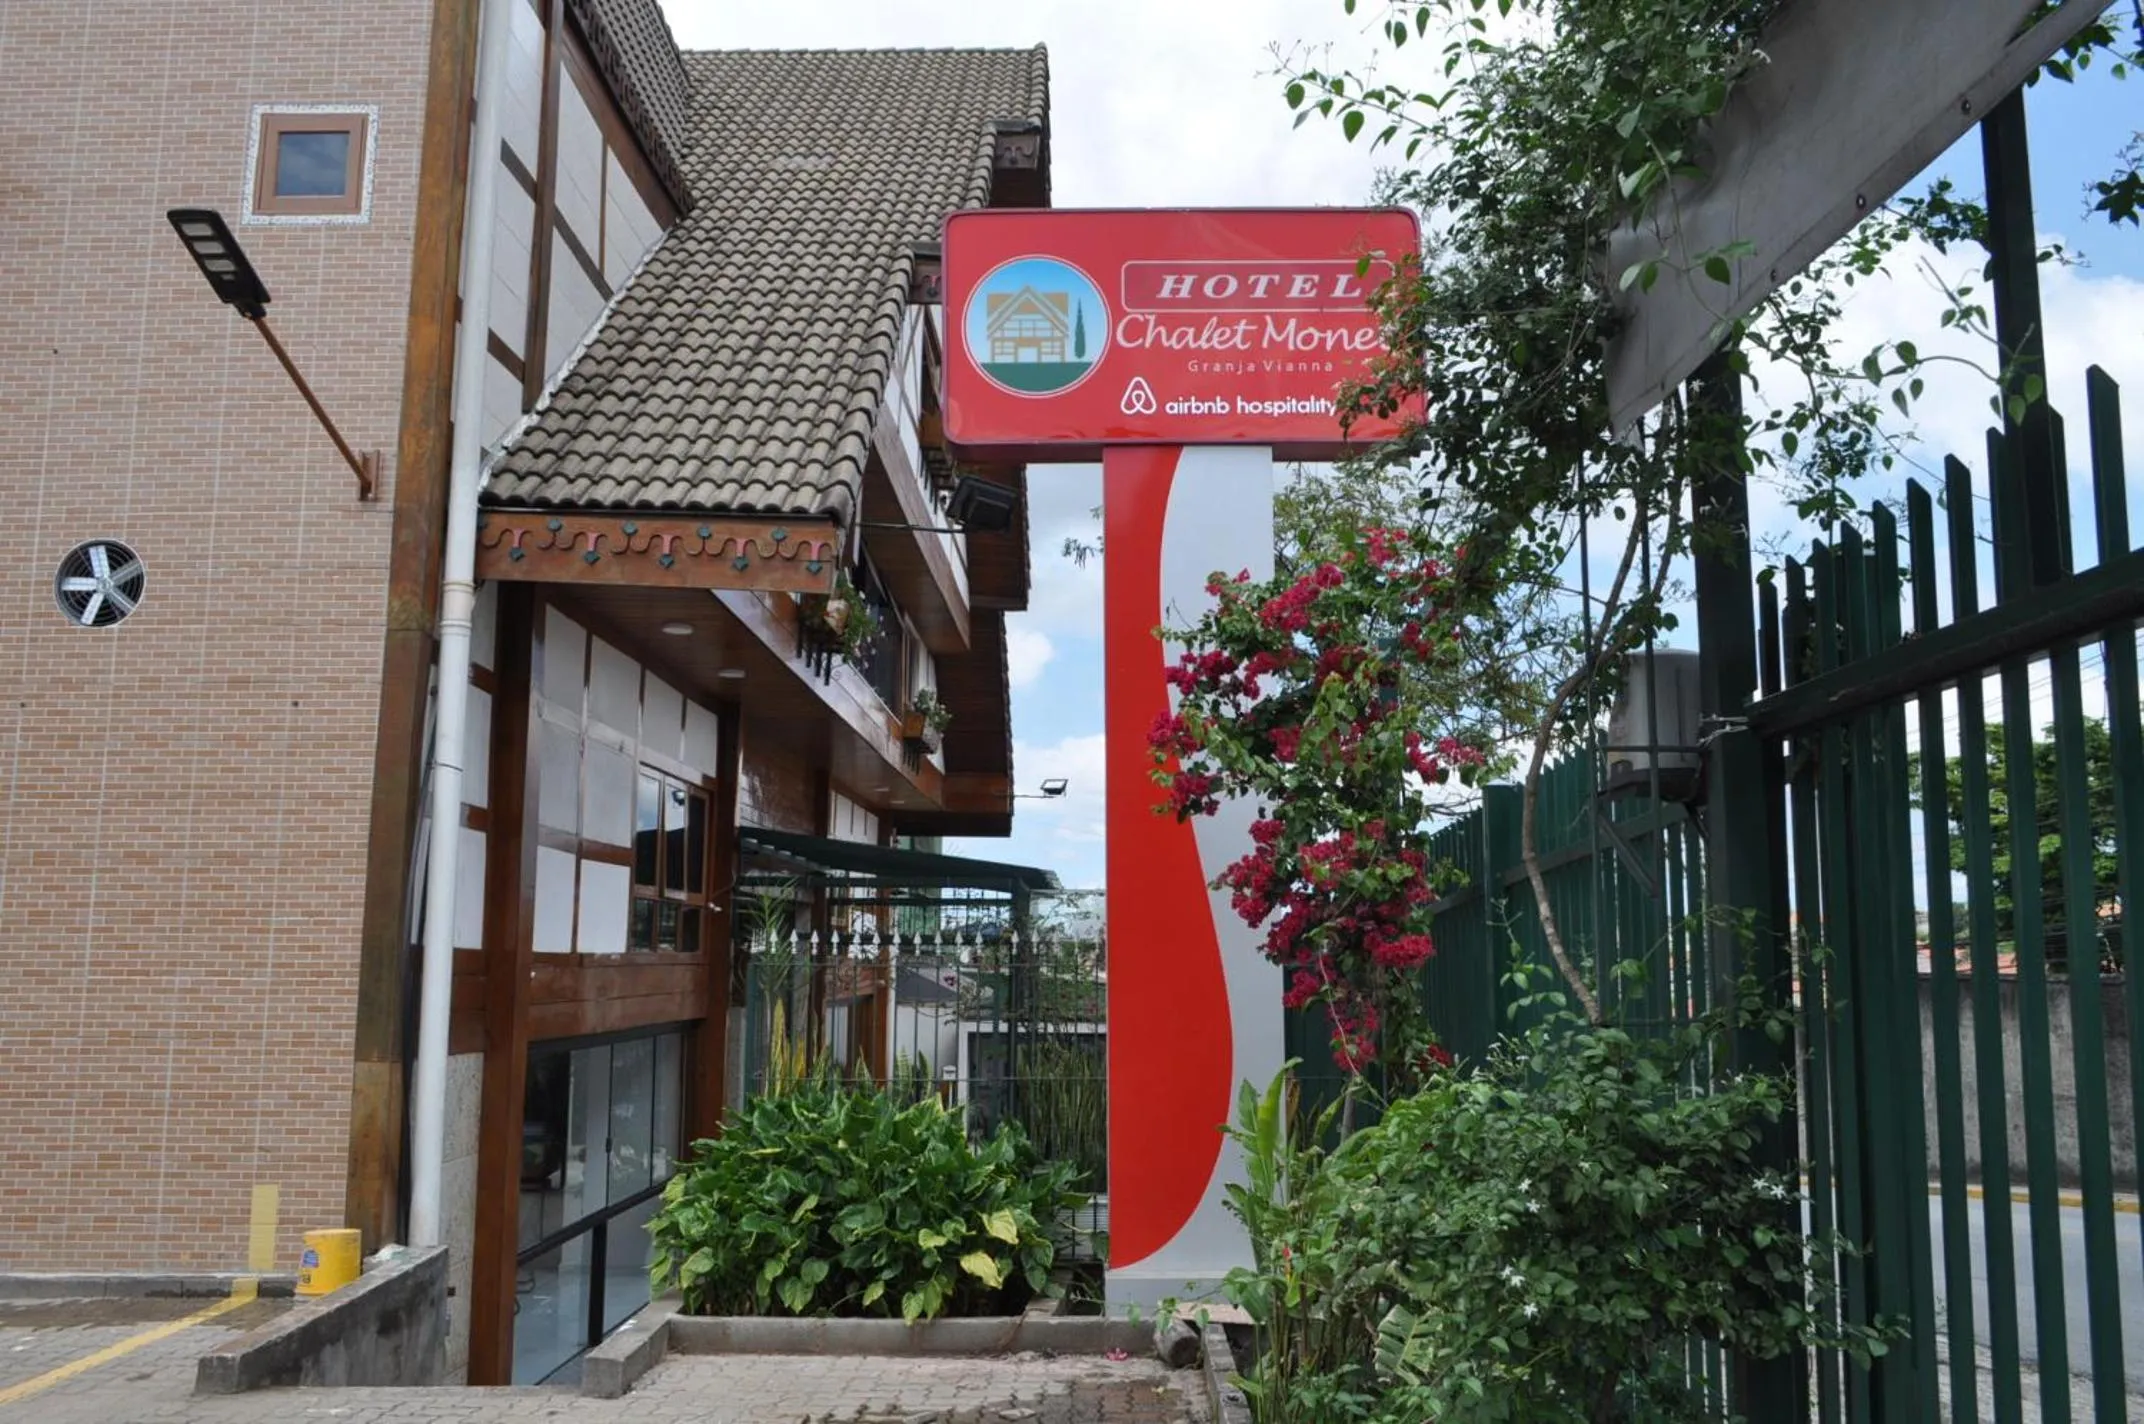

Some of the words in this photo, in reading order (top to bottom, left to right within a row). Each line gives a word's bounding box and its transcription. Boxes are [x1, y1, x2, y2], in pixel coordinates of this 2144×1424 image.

[1156, 274, 1363, 299] HOTEL
[1116, 313, 1258, 350] Chalet
[1188, 359, 1256, 375] Granja
[1262, 360, 1333, 373] Vianna
[1165, 396, 1230, 415] airbnb
[1237, 395, 1337, 417] hospitality
